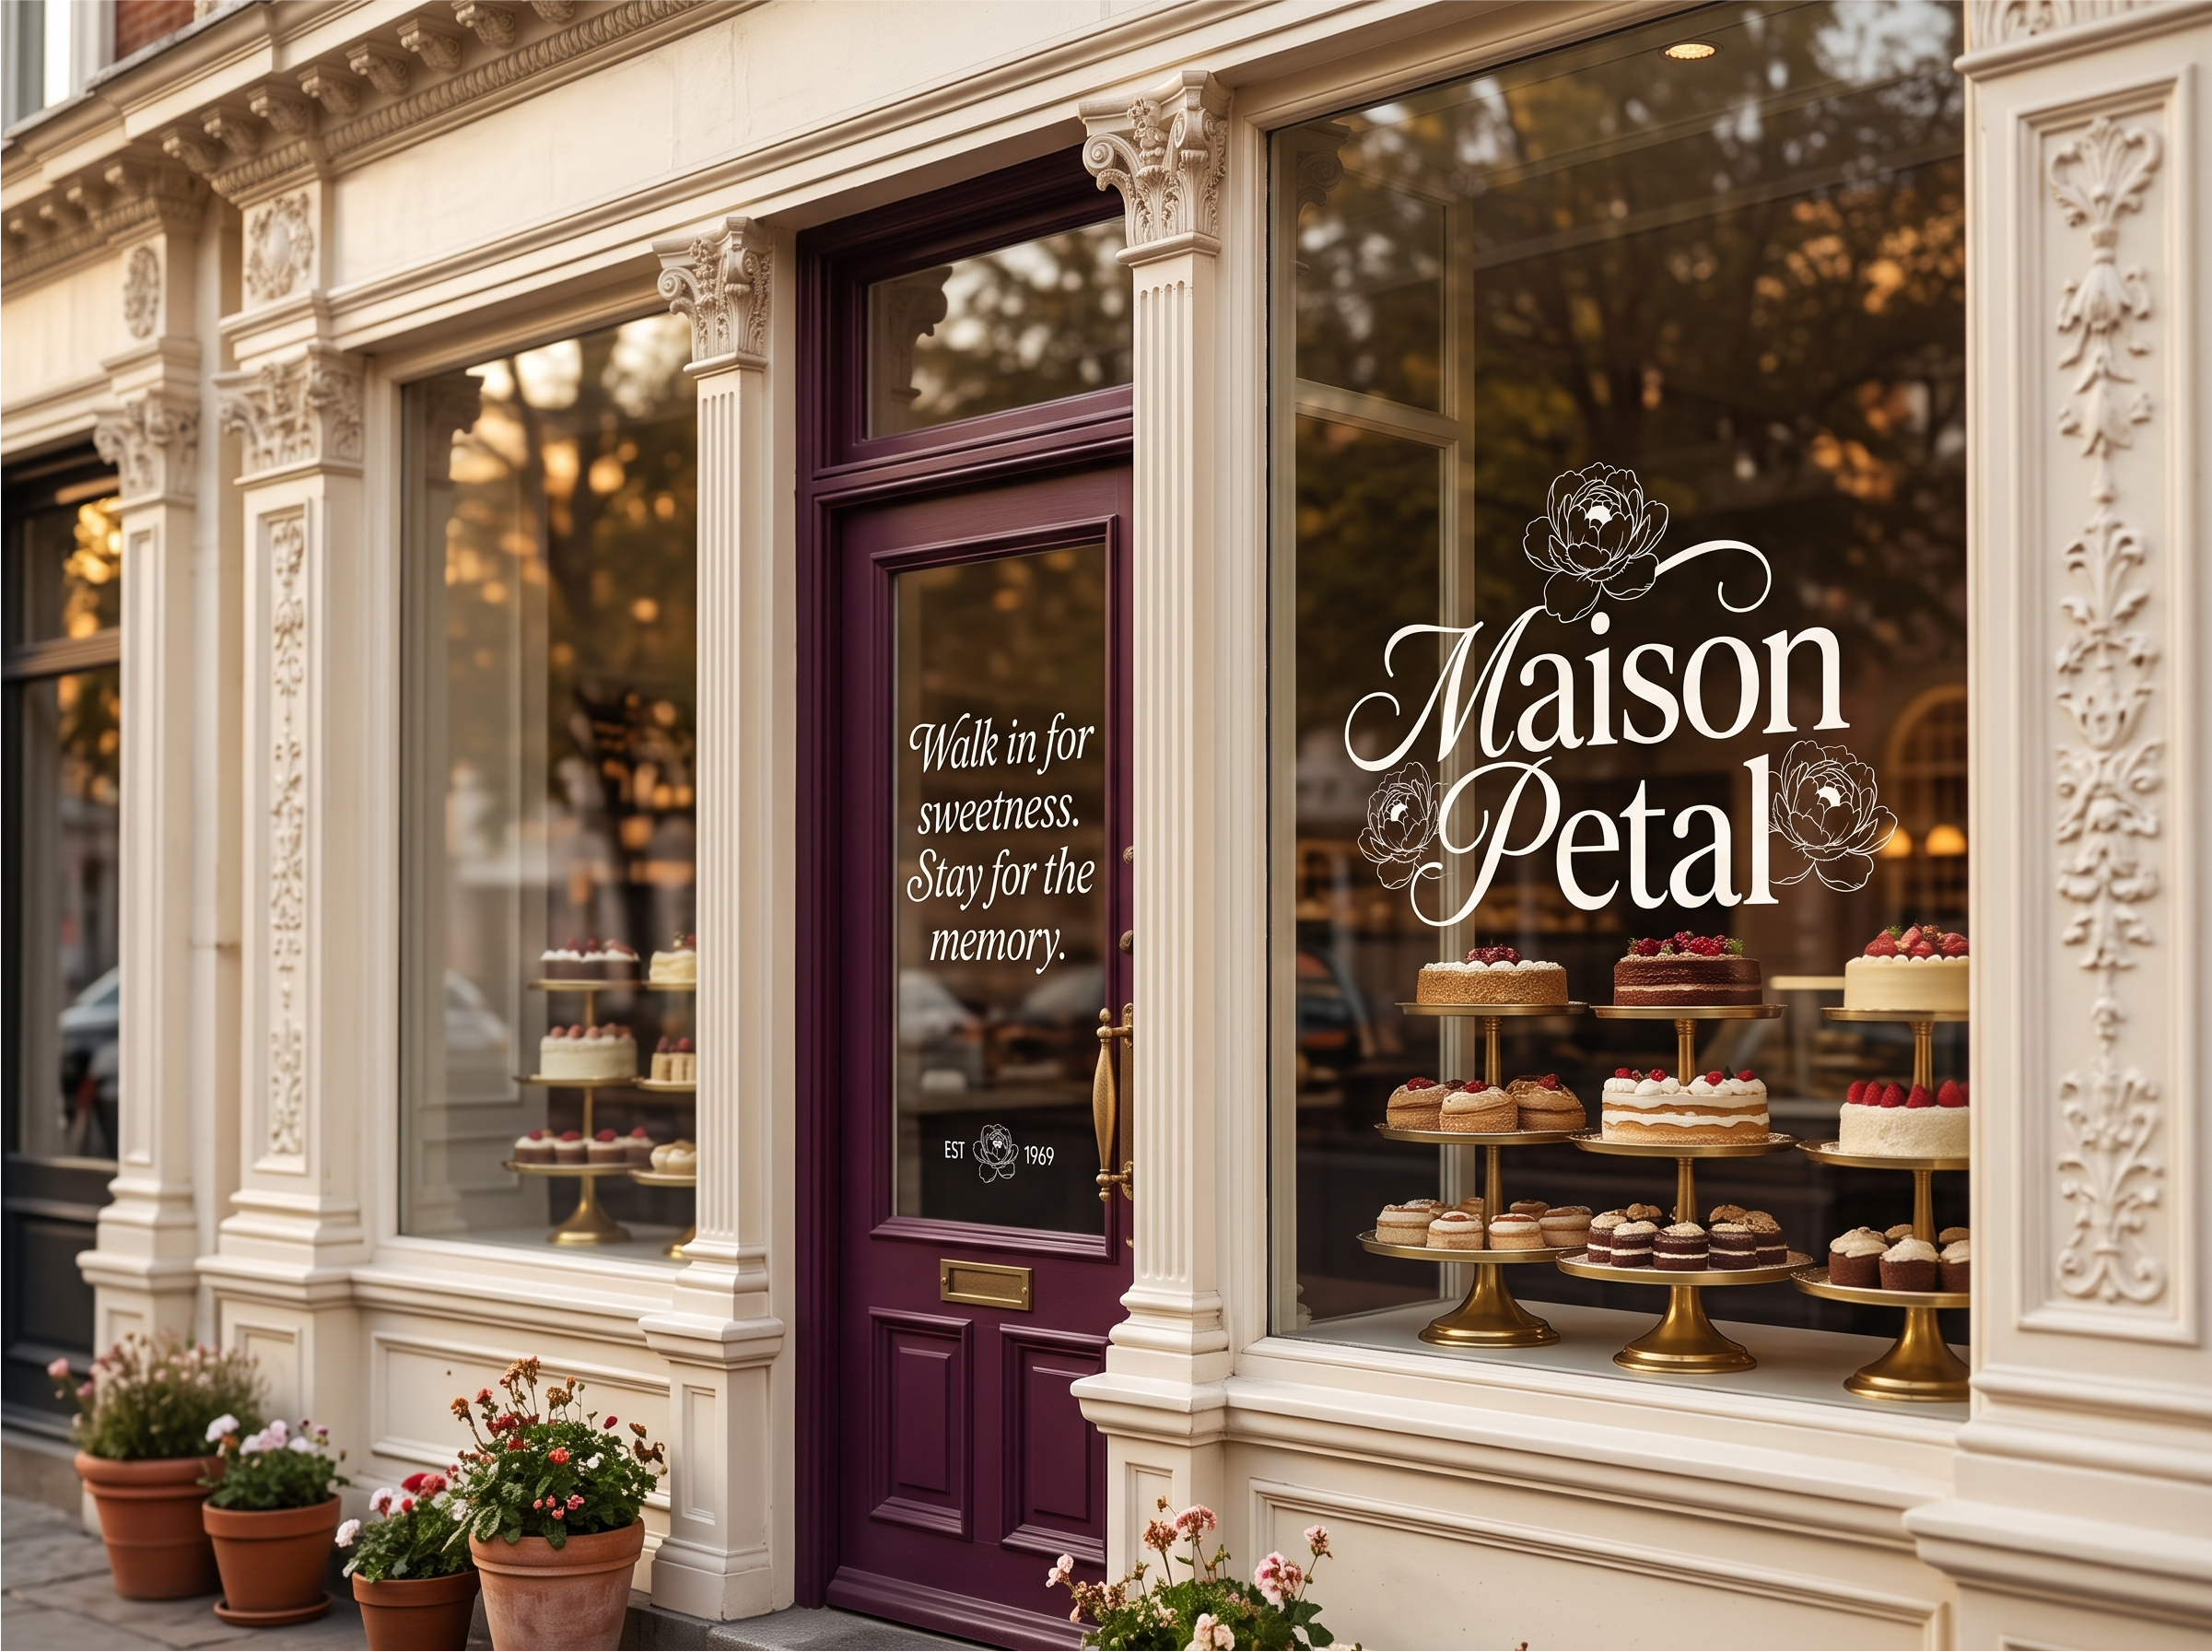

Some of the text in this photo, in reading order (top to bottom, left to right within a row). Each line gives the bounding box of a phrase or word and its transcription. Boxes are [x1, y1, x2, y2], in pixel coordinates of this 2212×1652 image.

[1344, 604, 1851, 772] Maison
[908, 711, 1094, 776] Walk in for
[918, 791, 1079, 835] sweetness.
[1410, 753, 1780, 927] Petal
[907, 846, 1095, 911] Stay for the
[930, 928, 1065, 975] memory.
[944, 1140, 1055, 1166] EST 1969
